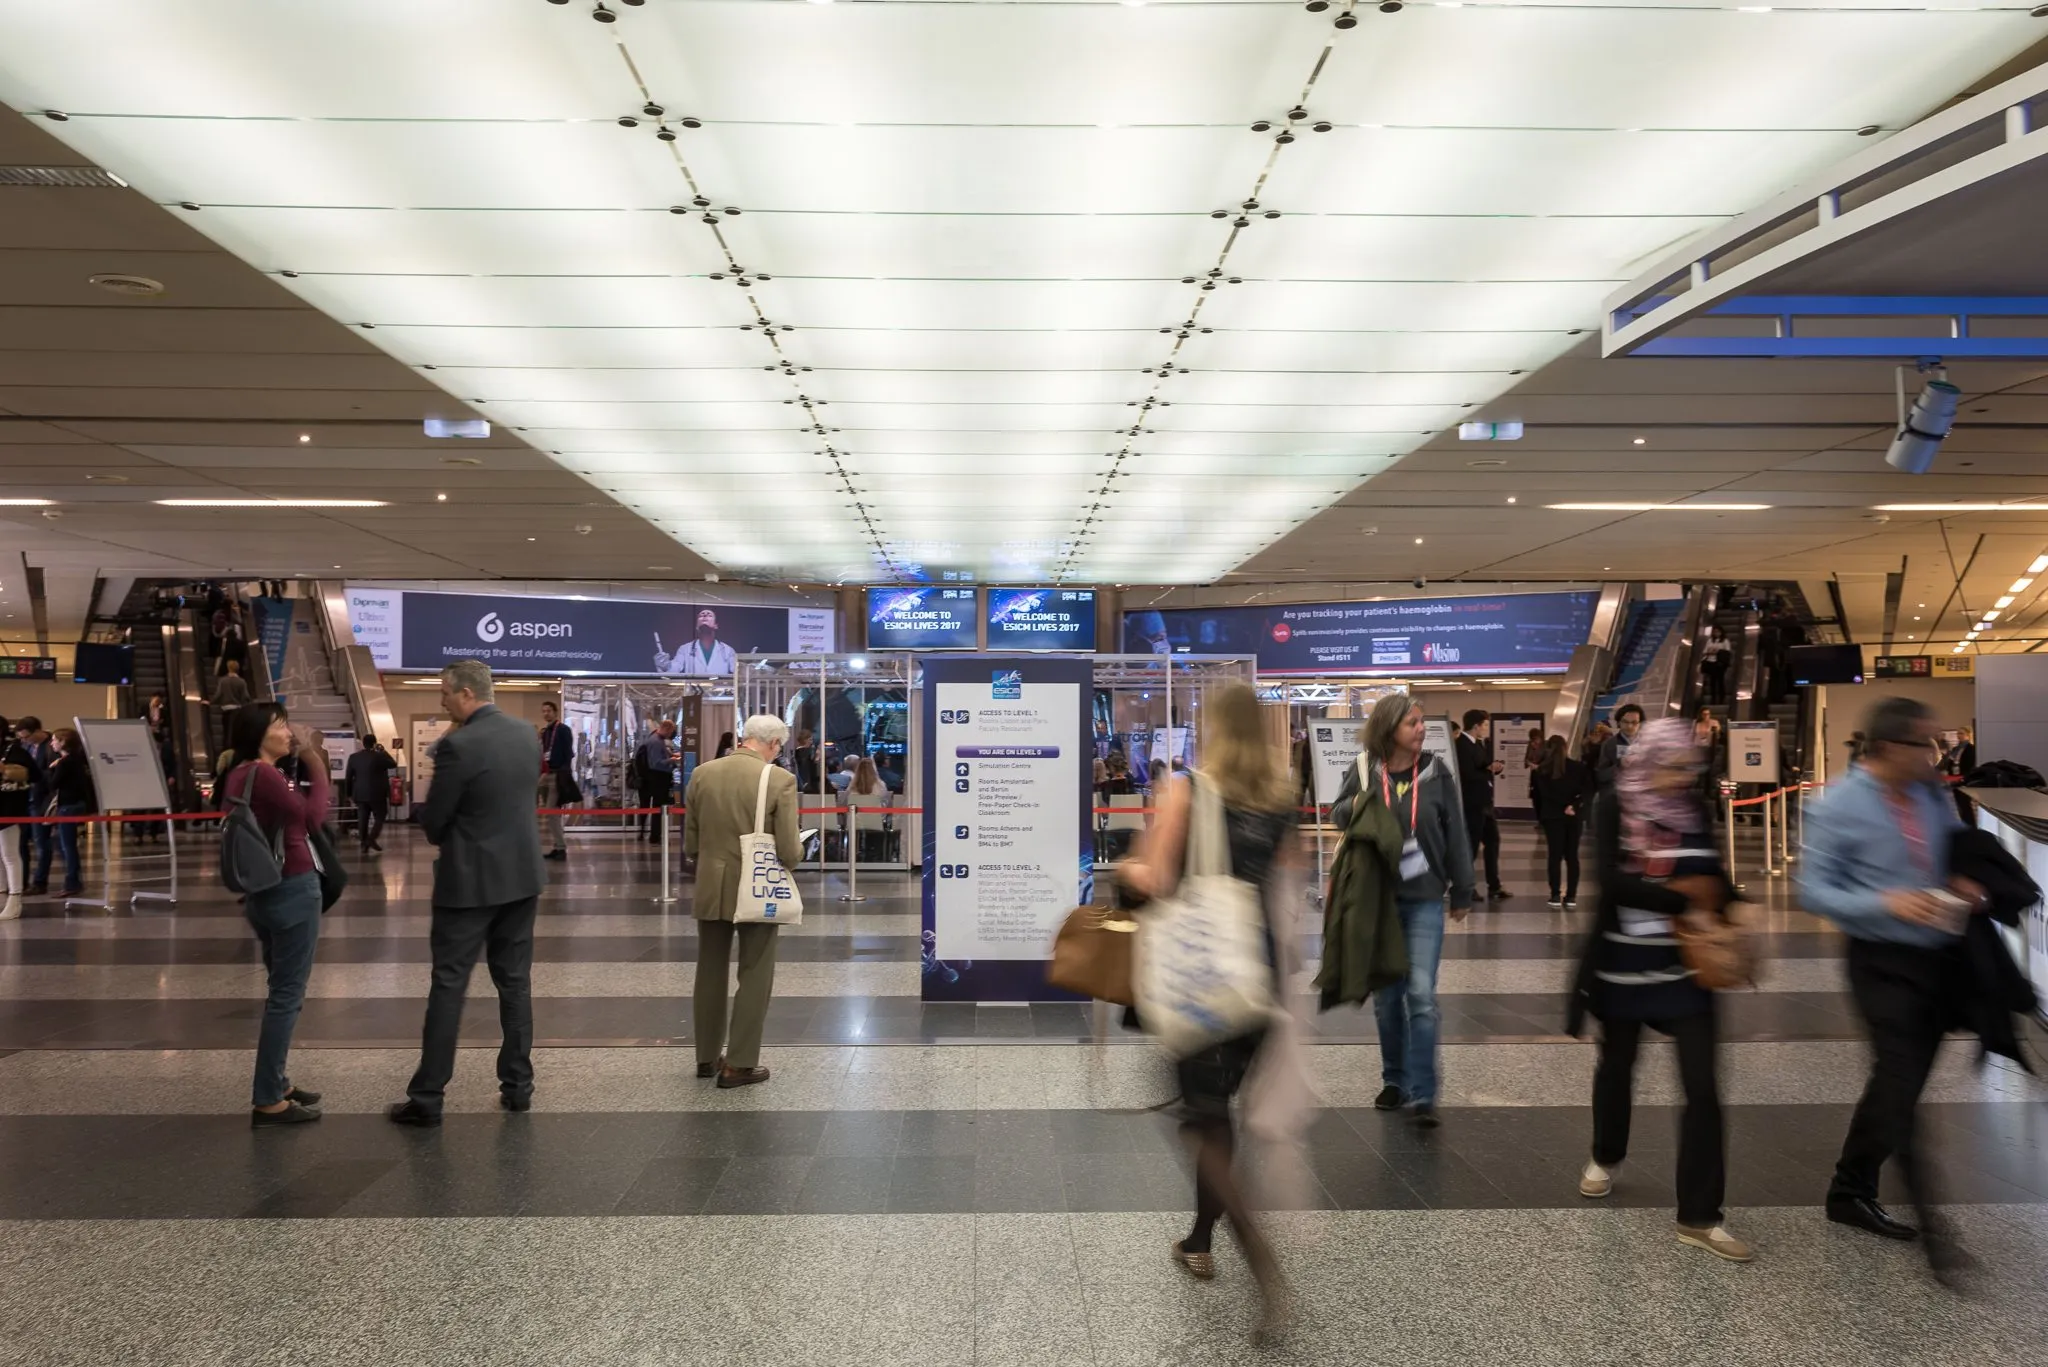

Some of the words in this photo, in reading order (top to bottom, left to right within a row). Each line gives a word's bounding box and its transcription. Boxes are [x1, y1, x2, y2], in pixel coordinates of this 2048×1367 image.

[893, 611, 938, 620] WELCOME
[939, 611, 952, 619] TO
[1283, 610, 1296, 619] Are
[1297, 612, 1311, 620] you
[1312, 609, 1343, 619] tracking
[1344, 609, 1362, 618] your
[1363, 606, 1398, 617] patient's
[1399, 604, 1453, 615] haemoglobin
[1012, 613, 1057, 621] WELCOME
[1058, 613, 1070, 621] TO
[509, 621, 573, 639] aspen
[884, 622, 912, 630] ESICM
[913, 622, 939, 630] LIVES
[940, 621, 961, 630] 2017
[1003, 623, 1031, 631] ESICM
[1032, 623, 1058, 631] LIVES
[1058, 623, 1080, 632] 2017
[1345, 627, 1368, 635] provides
[1400, 625, 1425, 633] visibility
[1432, 624, 1457, 632] changes
[1464, 622, 1506, 631] haemoglobin.
[442, 646, 491, 659] Mastering
[492, 647, 508, 657] the
[509, 648, 523, 658] art
[524, 648, 534, 658] of
[535, 649, 603, 661] Anaesthesiology
[1309, 646, 1330, 654] PLEASE
[1344, 645, 1352, 653] US
[1322, 749, 1338, 757] Self
[752, 885, 791, 899] LIVES
